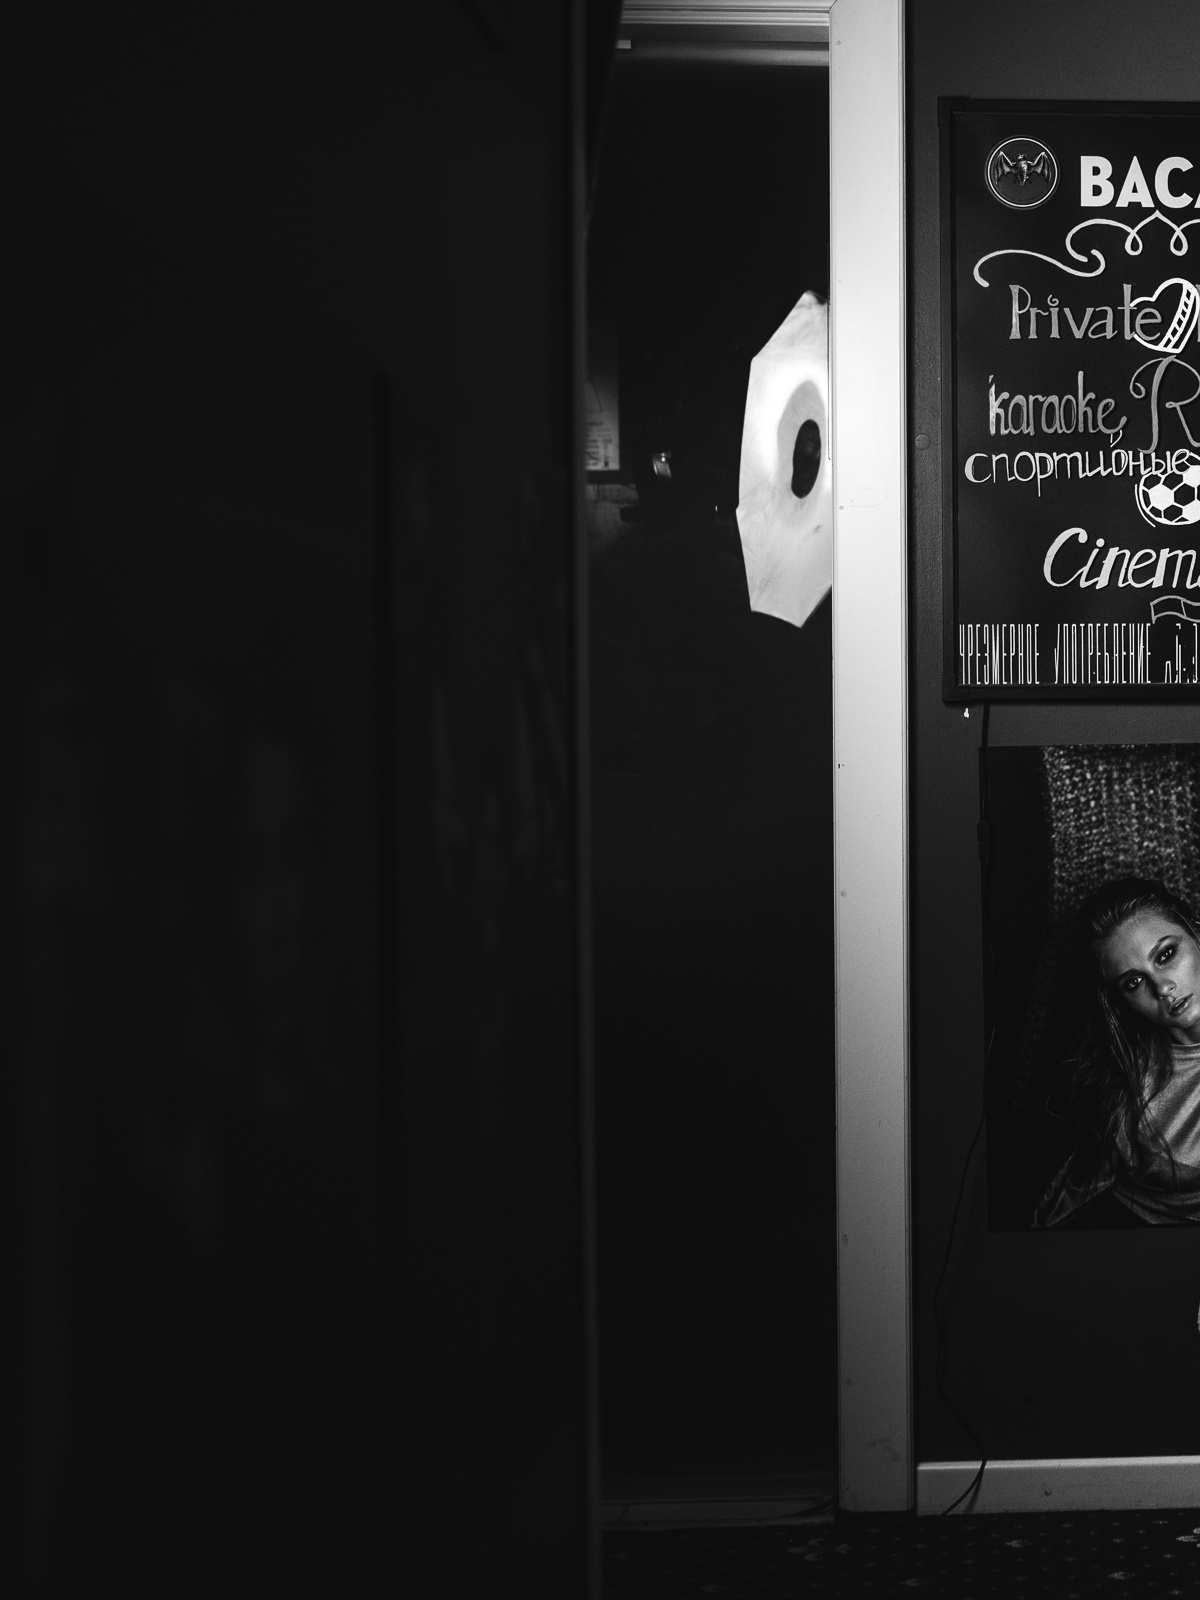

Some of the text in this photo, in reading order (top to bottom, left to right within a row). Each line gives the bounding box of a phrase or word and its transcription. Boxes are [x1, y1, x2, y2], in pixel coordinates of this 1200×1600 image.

[1009, 283, 1163, 341] Private
[964, 448, 1191, 498] спортивные
[959, 623, 1040, 685] ЧРЕЗМЕРНОЕ
[1054, 622, 1151, 684] УПОТРЕБЛЕНИЕ
